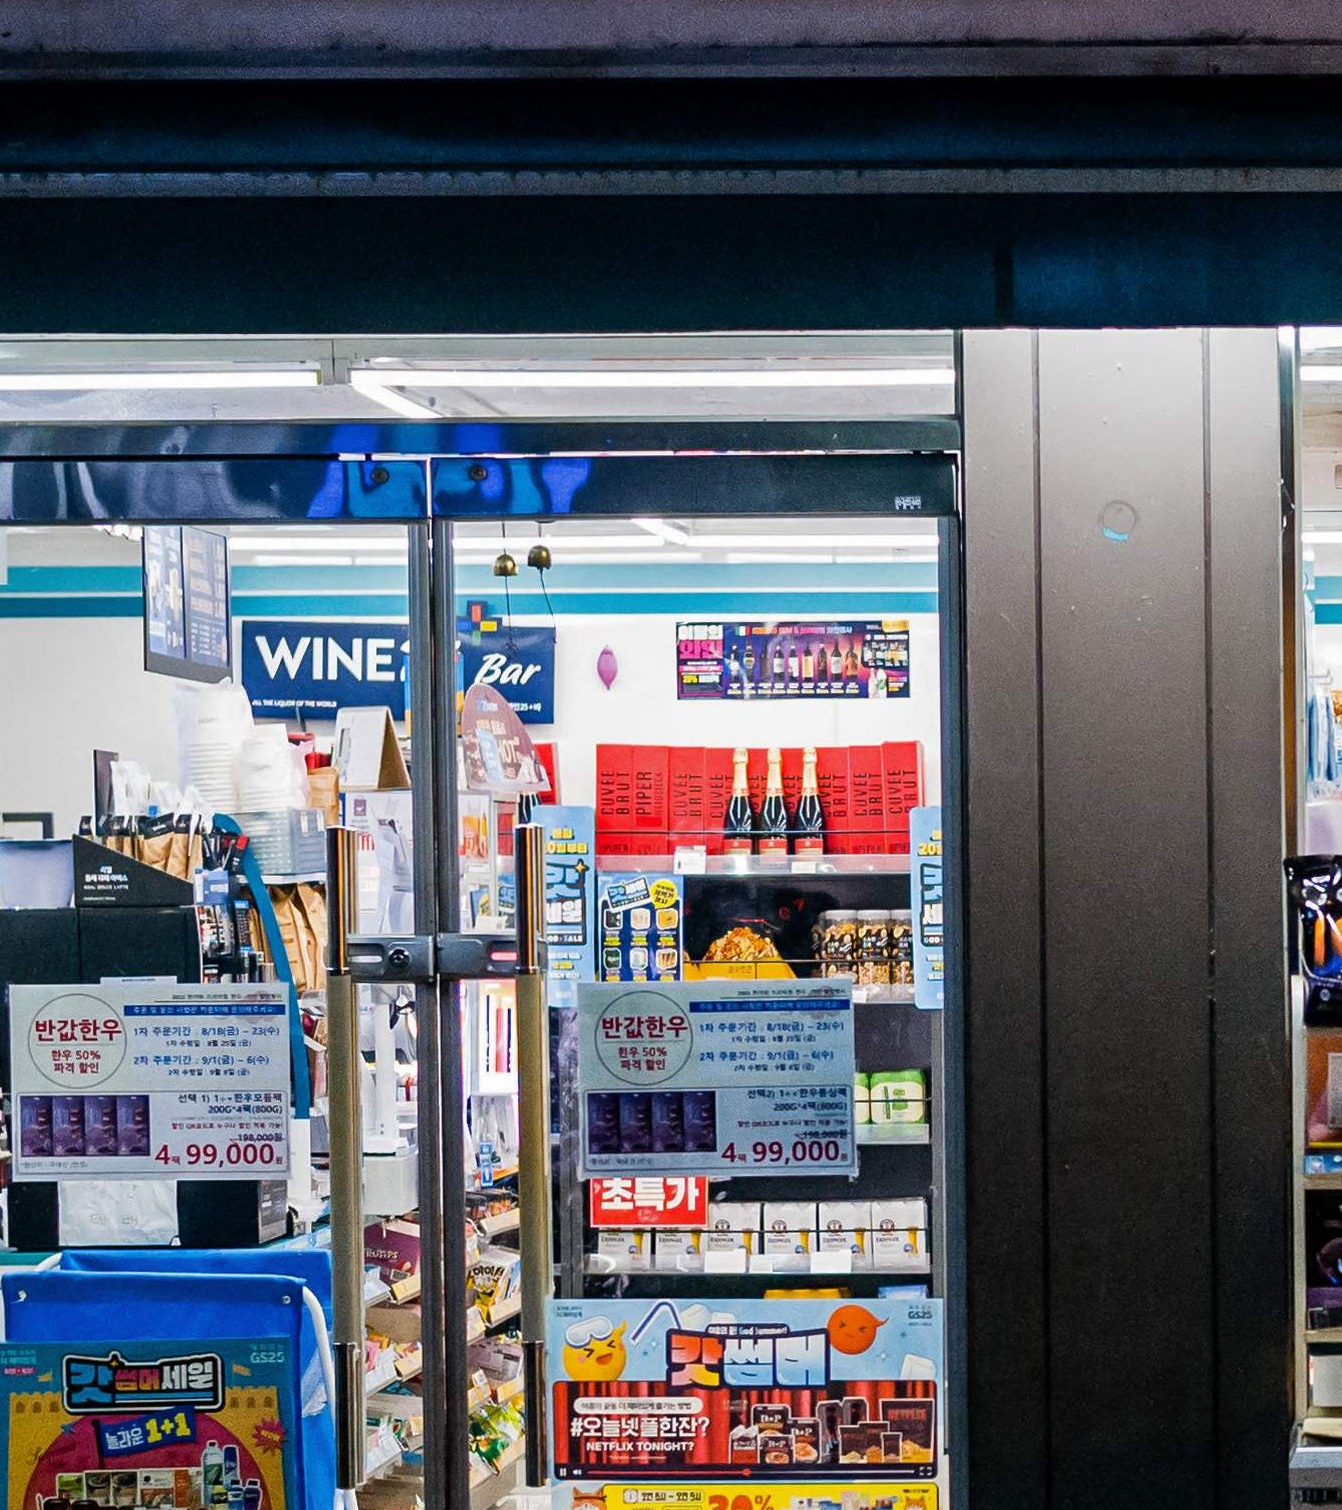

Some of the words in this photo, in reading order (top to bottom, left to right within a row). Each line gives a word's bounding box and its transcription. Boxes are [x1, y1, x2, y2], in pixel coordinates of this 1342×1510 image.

[475, 653, 541, 685] Bar
[601, 771, 614, 815] CUVEE
[616, 772, 629, 815] BRUT
[637, 770, 651, 815] PIPER
[674, 772, 687, 817] CUVEE
[689, 772, 702, 817] BRUT
[710, 774, 723, 818] CUVEE
[833, 774, 845, 817] BRUT
[854, 772, 867, 816] CUVEE
[869, 772, 881, 816] BRUT
[889, 769, 902, 813] CUVEE
[35, 1019, 122, 1042] 반값한우
[153, 1027, 191, 1036] 주문기간
[252, 1027, 280, 1036] 23(수)
[602, 1016, 688, 1039] 반값한우
[718, 1023, 756, 1032] 주문기간
[52, 1050, 72, 1061] 한우
[76, 1050, 101, 1061] 50%
[134, 1056, 148, 1065] 2차
[154, 1056, 191, 1065] 주문기간
[202, 1056, 234, 1065] 9/1(금)
[247, 1056, 269, 1065] 6(수)
[642, 1046, 667, 1058] 50%
[719, 1051, 756, 1061] 주문기간
[54, 1063, 75, 1074] 파격
[79, 1063, 99, 1074] 할인
[621, 1059, 642, 1071] 파격
[601, 1177, 698, 1211] 초특가
[908, 1310, 933, 1319] GS25
[251, 1352, 285, 1363] GS25
[146, 1412, 191, 1444] 1+1
[571, 1418, 709, 1437] #오늘넷플한잔?
[587, 1442, 634, 1451] NETFLIX
[637, 1442, 694, 1451] TONIGHT?
